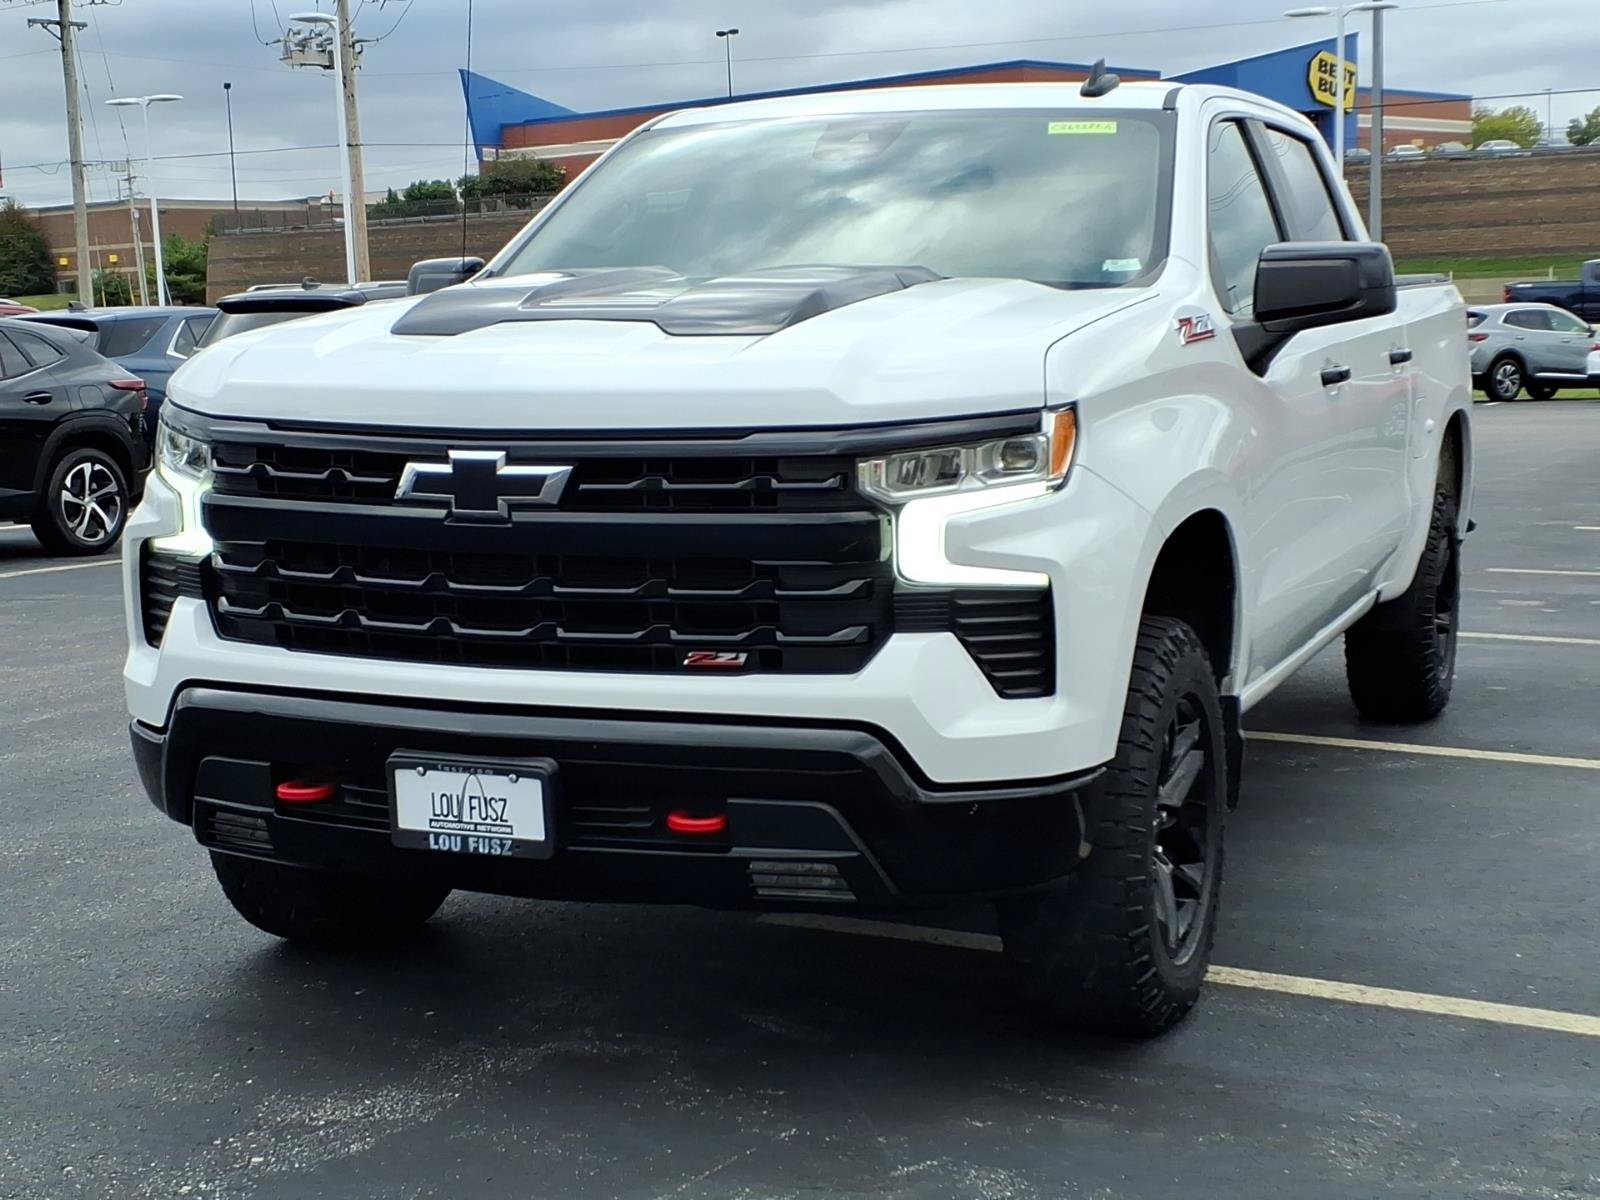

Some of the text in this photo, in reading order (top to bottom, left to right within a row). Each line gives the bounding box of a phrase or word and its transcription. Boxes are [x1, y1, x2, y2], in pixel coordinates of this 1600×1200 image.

[1318, 57, 1355, 85] BET
[1177, 312, 1217, 347] Z71
[683, 651, 748, 666] Z71
[431, 792, 509, 822] LOU FUSZ
[430, 821, 512, 833] AUTOMOTIVE NETWORK
[429, 833, 513, 856] LOU FUSZ
